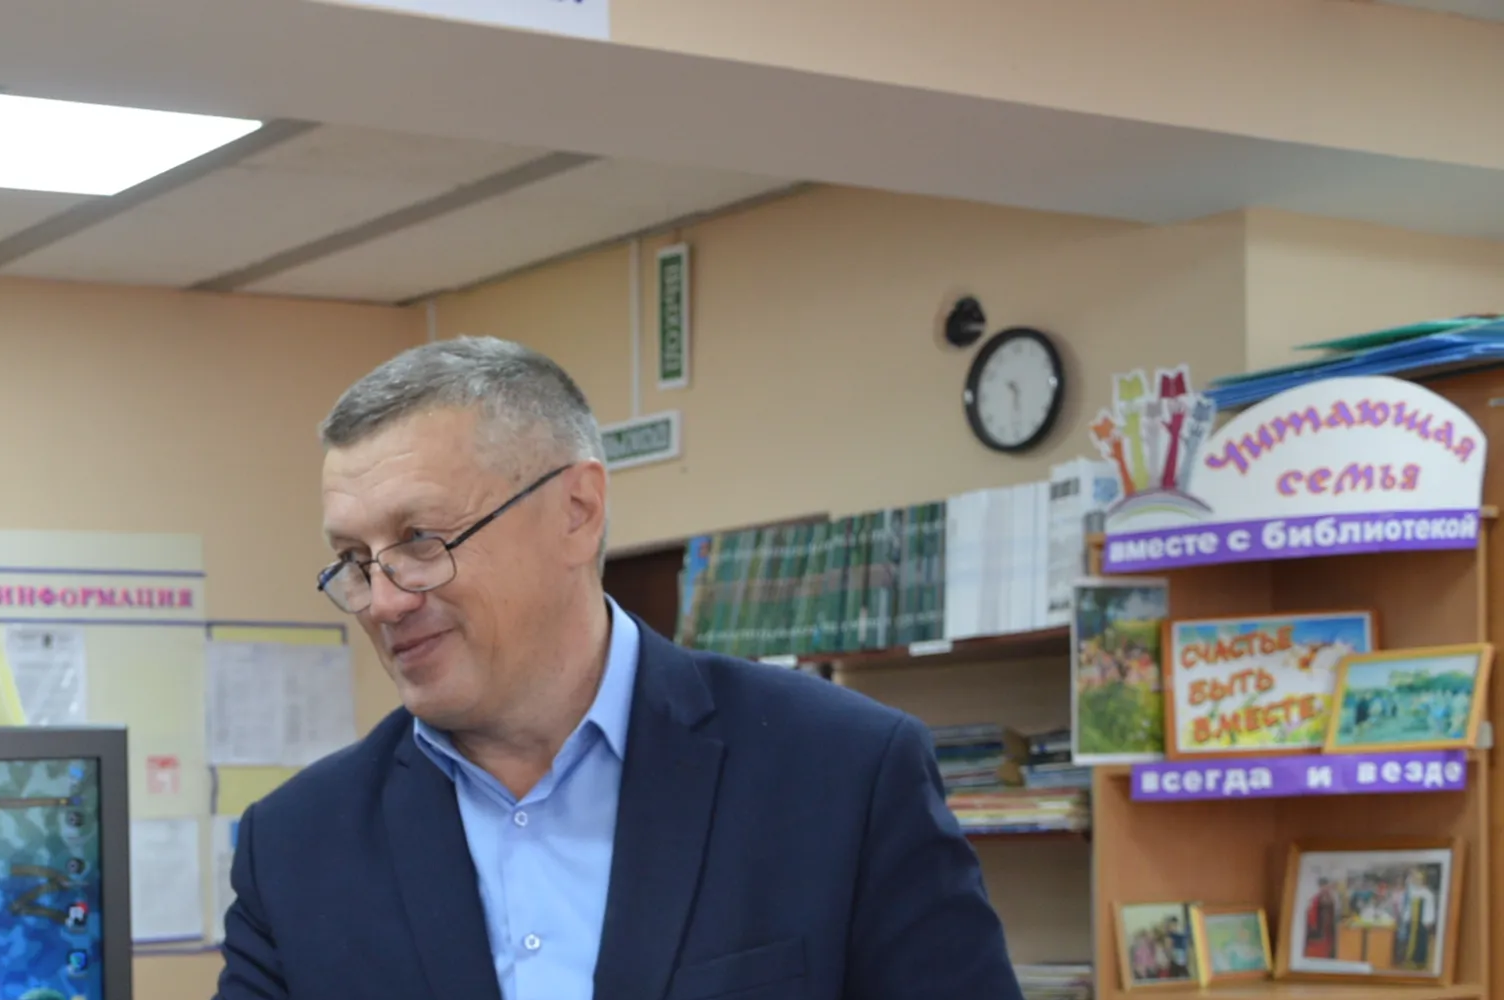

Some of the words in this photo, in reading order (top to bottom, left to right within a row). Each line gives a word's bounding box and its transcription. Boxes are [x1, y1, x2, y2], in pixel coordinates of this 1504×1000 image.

[1204, 398, 1477, 475] Читающая
[1276, 461, 1422, 496] семья
[1108, 528, 1220, 563] вместе
[1226, 527, 1252, 551] с
[1261, 512, 1478, 550] библиотекой
[1180, 624, 1297, 670] СЧАСТЬЕ
[1188, 667, 1275, 707] БЫТЬ
[1192, 693, 1319, 744] ВМЕСТЕ
[1141, 764, 1274, 796] всегда
[1306, 763, 1333, 789] и
[1357, 758, 1464, 789] везде
